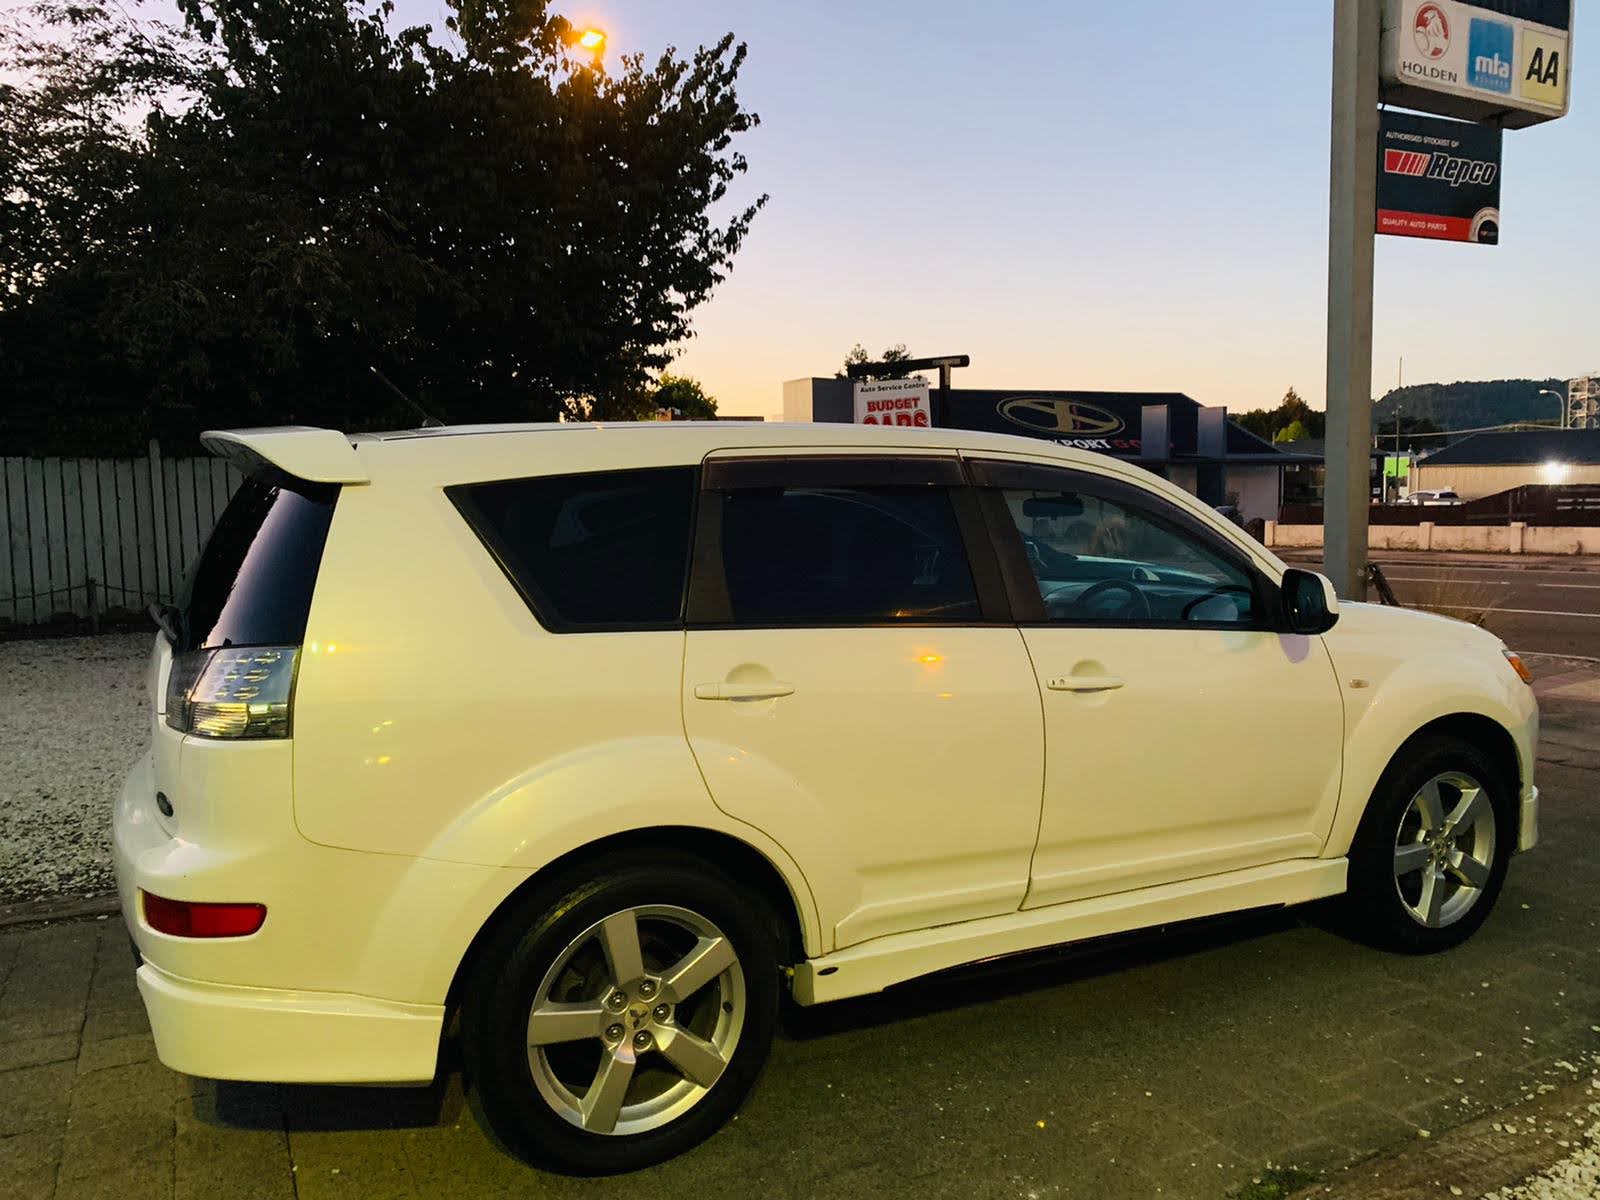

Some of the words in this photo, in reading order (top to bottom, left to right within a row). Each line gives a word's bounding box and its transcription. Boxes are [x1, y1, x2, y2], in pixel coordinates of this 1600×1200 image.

[1402, 61, 1458, 83] HOLDEN
[1475, 53, 1510, 78] mta
[1525, 46, 1559, 87] AA
[1385, 131, 1422, 143] AUTHORISED
[1427, 152, 1497, 186] Repco
[1382, 217, 1408, 227] QUALITY
[1409, 221, 1426, 229] AUTO
[1426, 223, 1448, 231] PARTS
[877, 384, 902, 392] Service
[867, 398, 920, 412] BUDGET
[1049, 439, 1111, 449] PORT
